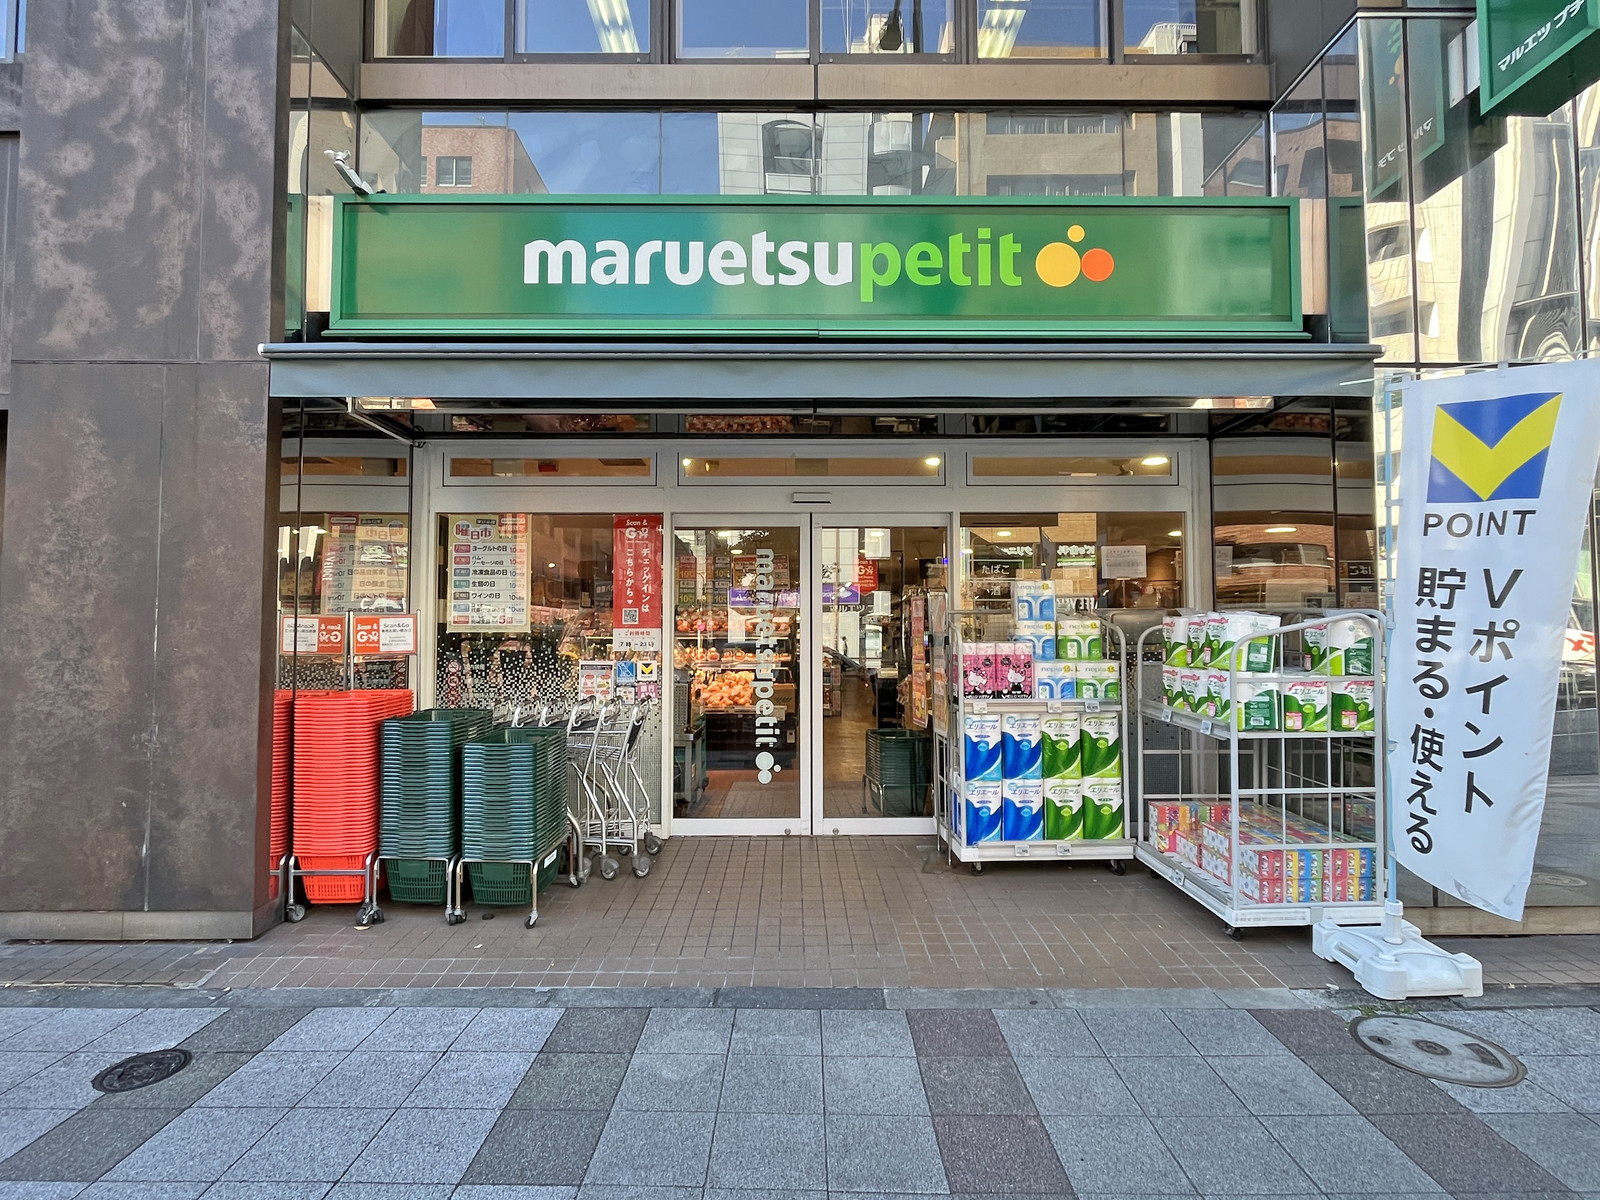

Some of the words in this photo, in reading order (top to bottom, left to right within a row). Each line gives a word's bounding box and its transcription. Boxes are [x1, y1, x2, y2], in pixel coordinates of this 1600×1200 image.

[1498, 21, 1552, 72] マルエツ
[1423, 510, 1537, 537] POINT
[626, 549, 635, 597] こちらから
[641, 548, 651, 612] チェックインは
[981, 565, 1010, 575] たばこ
[1405, 567, 1466, 855] 貯まる・使える
[1462, 568, 1524, 814] Vポイント
[1086, 720, 1118, 728] エリエール
[1051, 788, 1082, 796] エリエール
